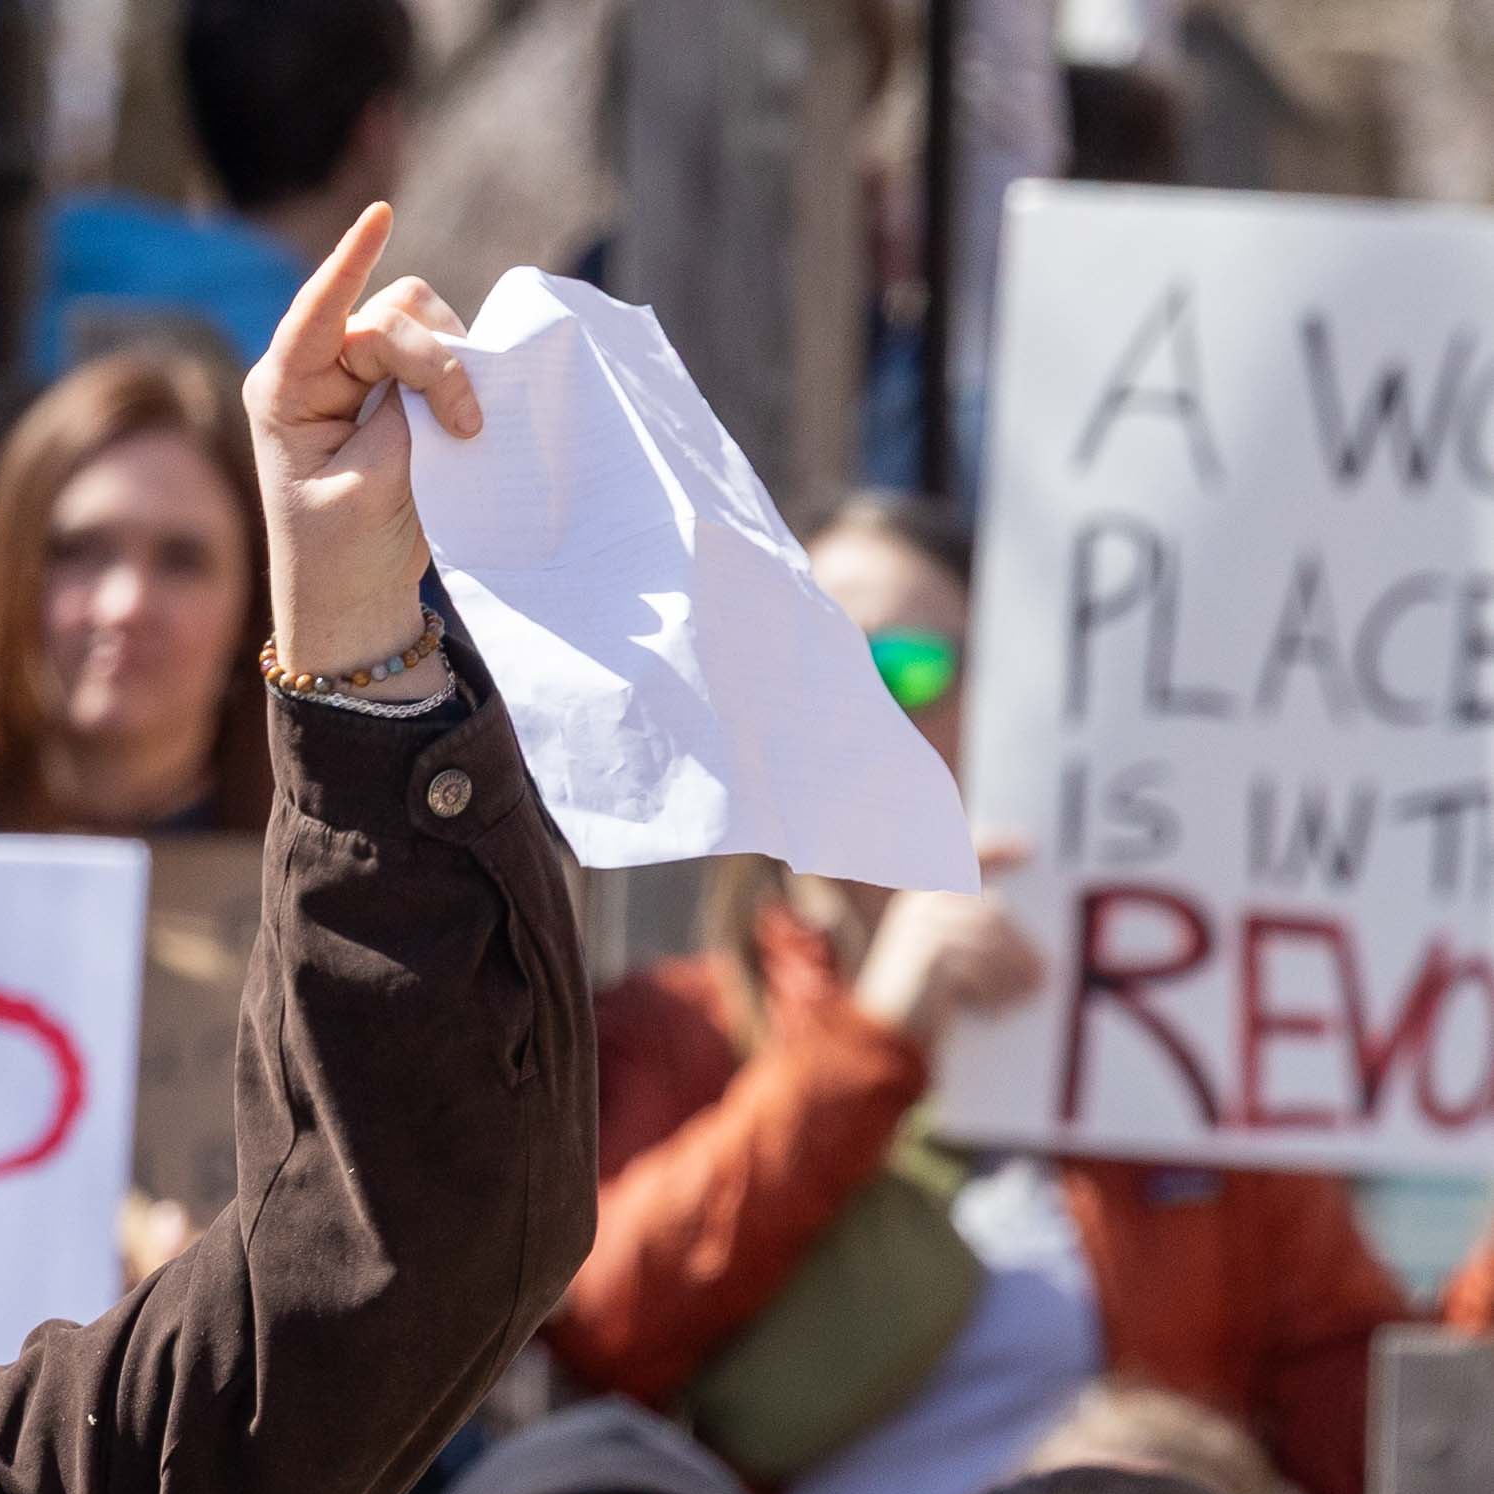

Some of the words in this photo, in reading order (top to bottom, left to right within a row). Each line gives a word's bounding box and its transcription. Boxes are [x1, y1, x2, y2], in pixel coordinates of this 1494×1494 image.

[1071, 280, 1223, 490] A
[1064, 510, 1494, 730] PLACE
[1057, 760, 1183, 866] IS
[1245, 772, 1381, 888] IN
[1058, 885, 1494, 1132] REVO
